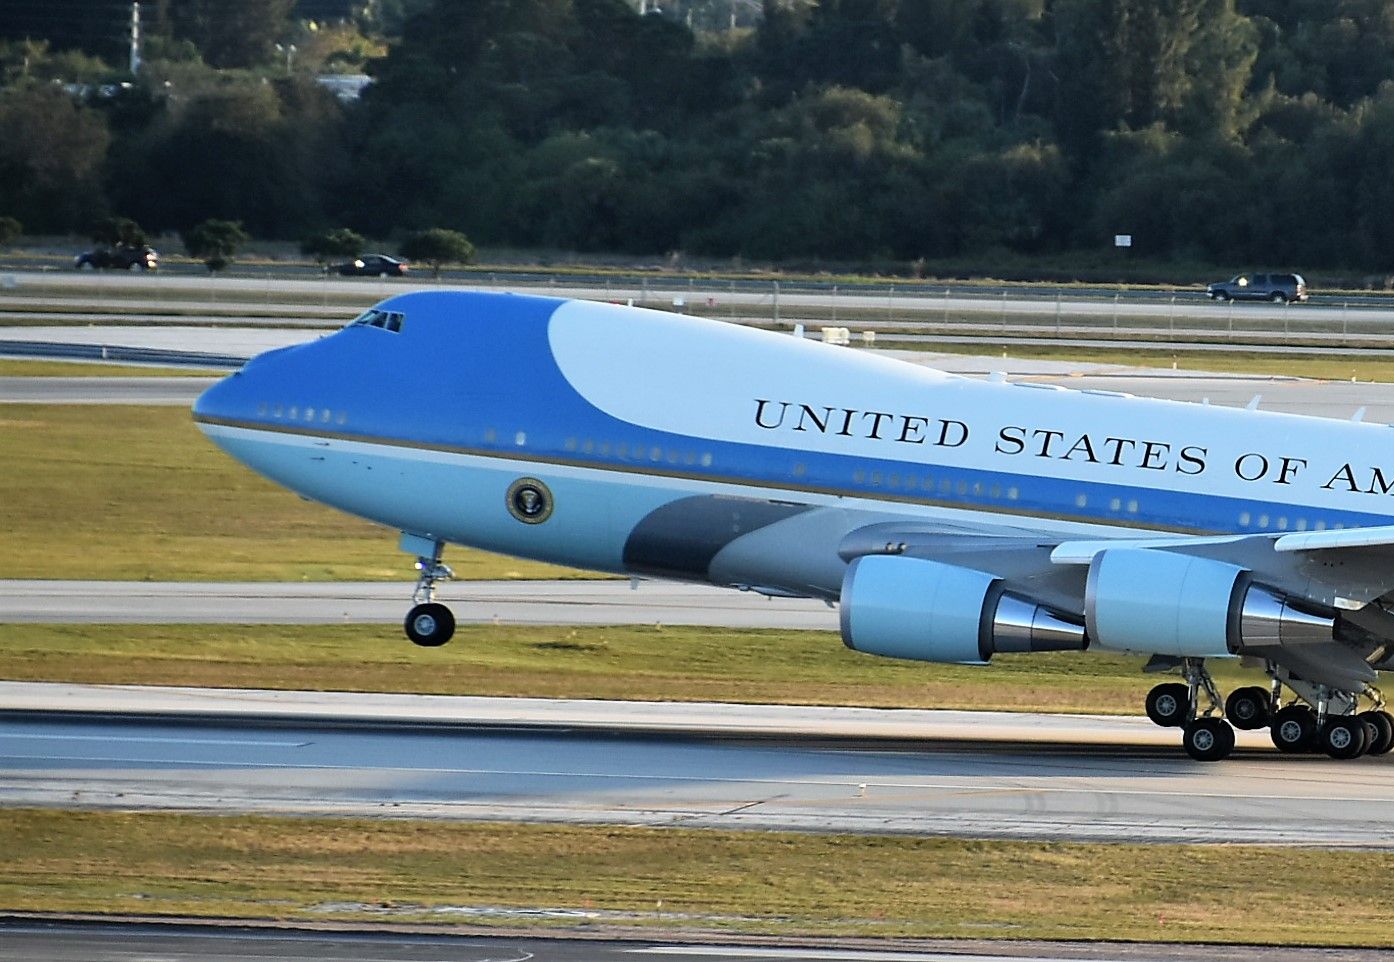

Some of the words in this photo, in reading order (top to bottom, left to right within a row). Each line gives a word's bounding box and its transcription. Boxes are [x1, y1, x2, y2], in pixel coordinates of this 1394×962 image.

[754, 399, 970, 448] UNITED
[994, 426, 1209, 475] STATES
[1234, 453, 1307, 485] OF
